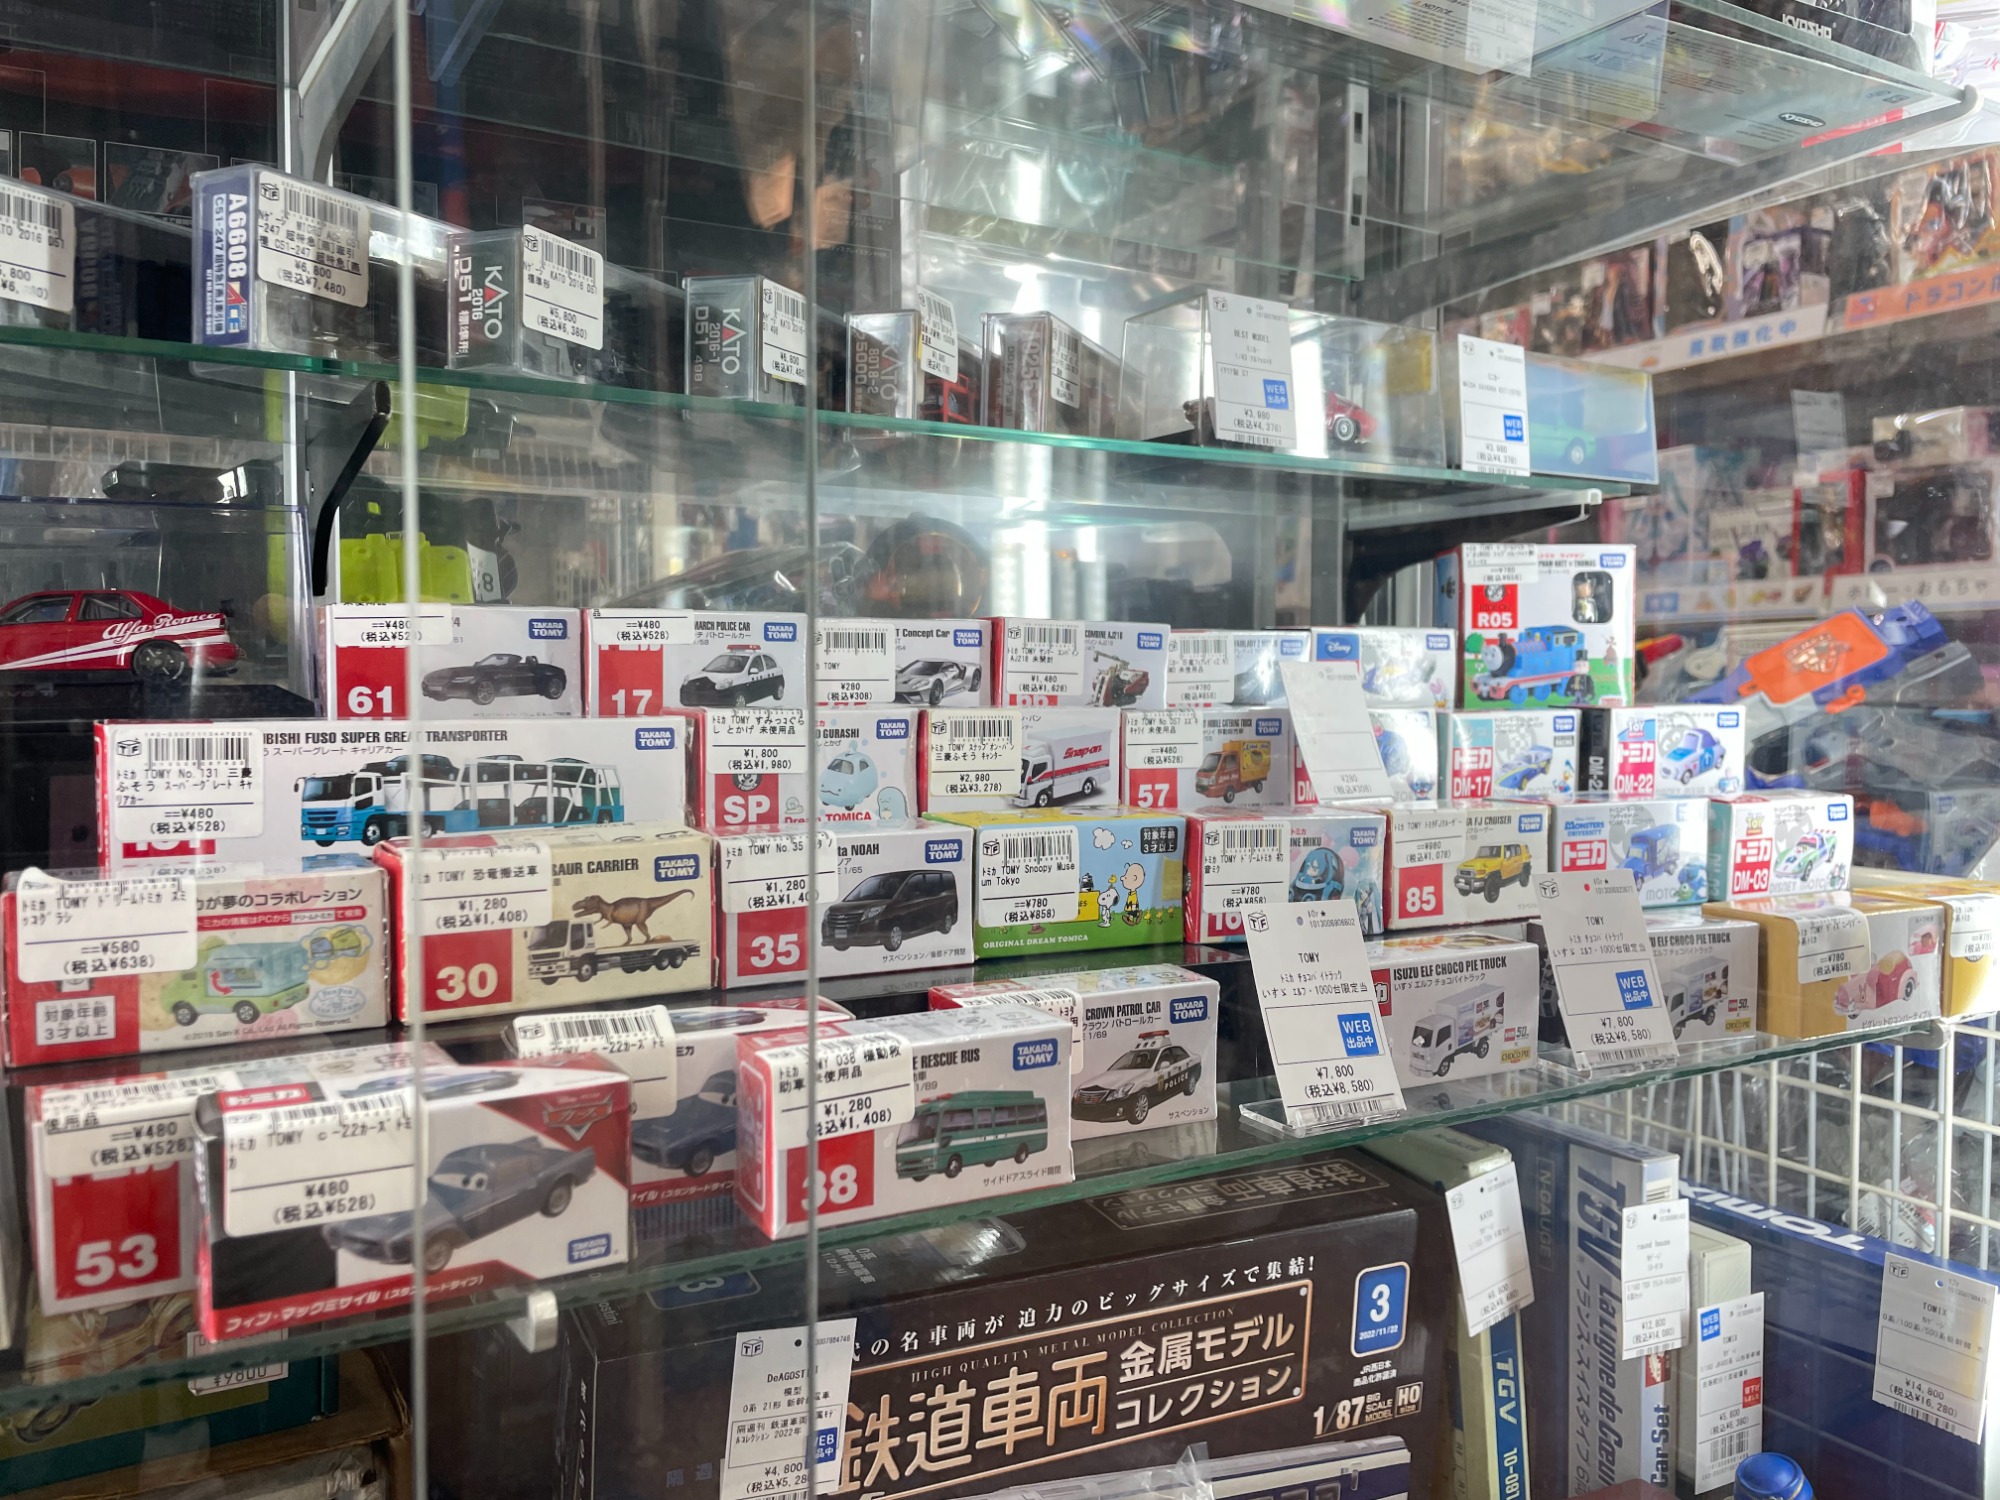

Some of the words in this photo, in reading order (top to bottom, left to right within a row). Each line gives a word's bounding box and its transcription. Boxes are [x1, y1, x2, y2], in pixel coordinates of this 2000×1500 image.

[1782, 13, 1833, 41] KYOSHO
[228, 193, 248, 279] A6608
[458, 255, 472, 303] D51
[471, 287, 484, 321] 2016
[484, 265, 509, 340] KATO
[549, 306, 578, 325] ¥5,800
[536, 314, 588, 340] (税込¥6,380)
[694, 305, 710, 346] D51
[708, 322, 721, 363] 2016-1
[721, 308, 748, 376] KATO
[1266, 384, 1286, 396] WEB
[102, 620, 153, 645] Alfa
[153, 611, 217, 630] Romeo
[531, 621, 564, 630] TAKARA
[716, 621, 740, 632] POLICE
[740, 621, 751, 632] CAR
[1477, 612, 1513, 628] R05
[531, 629, 564, 638] TOMY
[616, 631, 670, 641] (税込¥528)
[766, 632, 794, 640] TOMY
[902, 628, 936, 640] Concept
[935, 628, 951, 638] Car
[1139, 641, 1161, 649] TOMY
[1325, 641, 1352, 655] Disney
[840, 682, 861, 691] ¥280
[347, 685, 394, 715] 61
[611, 688, 653, 716] 17
[827, 691, 873, 701] (税込¥308)
[731, 716, 750, 724] TOMY
[879, 721, 906, 730] TAKARA
[305, 731, 337, 744] FUSO
[340, 731, 381, 744] SUPER
[425, 729, 508, 743] TRANSPORTER
[638, 730, 672, 739] TAKARA
[726, 725, 754, 735] とかげ
[759, 725, 796, 735] 未使用品
[822, 727, 860, 739] GURASHI
[879, 729, 906, 737] TOMY
[638, 738, 672, 748] TOMY
[743, 749, 779, 758] ¥1,800
[1062, 744, 1104, 760] Snap-on
[1453, 749, 1492, 771] トミカ
[1618, 741, 1655, 763] トミカ
[727, 759, 792, 770] (税込¥1,980)
[1143, 756, 1184, 765] (税込¥528)
[144, 768, 171, 779] TOMY
[959, 773, 990, 783] ¥2,980
[116, 781, 156, 792] ふそう
[944, 782, 1003, 793] (税込¥3,278)
[1453, 776, 1491, 798] DM-17
[1614, 773, 1654, 794] DM-22
[1137, 783, 1170, 809] 57
[723, 794, 771, 825] SP
[824, 810, 872, 822] TOMICA
[149, 819, 226, 835] (税込¥528)
[1483, 814, 1512, 826] CRUISER
[1564, 819, 1605, 831] MONSTERS
[928, 842, 960, 852] TAKARA
[1303, 836, 1322, 847] MIKU
[1352, 836, 1377, 845] TOMY
[850, 843, 880, 857] NOAH
[928, 850, 960, 860] TOMY
[1563, 841, 1606, 867] トミカ
[1735, 838, 1772, 864] トミカ
[586, 857, 640, 875] CARRIER
[657, 857, 697, 869] TAKARA
[1001, 864, 1020, 876] TOMY
[1024, 863, 1053, 875] Snoopy
[657, 867, 697, 880] TOMY
[997, 876, 1020, 886] Tokyo
[1733, 868, 1769, 891] DM-03
[765, 879, 807, 894] ¥1,280
[458, 897, 508, 912] ¥1,280
[1405, 885, 1436, 913] 85
[435, 911, 529, 930] (税込¥1,408)
[1004, 909, 1056, 924] (税込¥858)
[982, 938, 1025, 949] ORIGINAL
[1026, 936, 1056, 947] DREAM
[1057, 934, 1089, 944] TOMICA
[1669, 934, 1695, 947] CHOCO
[1706, 932, 1731, 944] TRUCK
[749, 932, 800, 968] 35
[1297, 951, 1320, 964] TOMY
[63, 955, 155, 974] (税込¥638)
[1393, 967, 1420, 981] ISUZU
[1420, 965, 1434, 978] ELF
[1435, 962, 1465, 976] CHOCO
[1465, 959, 1479, 973] PIE
[1479, 955, 1508, 971] TRUCK
[435, 962, 499, 1003] 30
[1619, 975, 1646, 990] WEB
[1173, 999, 1205, 1010] TAKARA
[1624, 990, 1649, 1003] 出品中
[1085, 1005, 1116, 1022] CROWN
[1116, 1002, 1145, 1018] PATROL
[1145, 1000, 1162, 1014] CAR
[1173, 1008, 1206, 1021] TOMY
[1341, 1019, 1372, 1034] WEB
[1600, 1016, 1634, 1028] ¥7,800
[44, 1025, 108, 1041] 3才以上
[1590, 1029, 1652, 1045] (税込¥8,580)
[1017, 1042, 1054, 1056] TAKARA
[1346, 1035, 1374, 1049] 出品中
[920, 1051, 958, 1070] RESCUE
[960, 1048, 981, 1064] BUS
[1017, 1052, 1055, 1068] TOMY
[1316, 1064, 1355, 1079] ¥7,800
[1164, 1072, 1190, 1090] POLICE
[1304, 1078, 1375, 1099] (税込¥8,580)
[824, 1096, 873, 1117] ¥1,280
[266, 1131, 304, 1149] TOMY
[305, 1179, 349, 1197] ¥480
[801, 1163, 858, 1210] 38
[273, 1194, 376, 1225] (税込¥528)
[1576, 1165, 1629, 1281] TGV
[572, 1238, 608, 1252] TAKARA
[572, 1246, 609, 1260] TOMY
[74, 1233, 158, 1287] 53
[1369, 1283, 1391, 1323] 3
[1922, 1301, 1948, 1317] TOMIX
[225, 1289, 382, 1334] フィン・マックミサイル
[1701, 1312, 1719, 1326] WEB
[1358, 1324, 1400, 1341] 2022/11/22
[911, 1368, 953, 1384] HIGH
[958, 1348, 1032, 1373] QUALITY
[1038, 1335, 1090, 1358] METAL
[1096, 1324, 1146, 1345] MODEL
[1150, 1307, 1236, 1333] COLLECTION
[1118, 1311, 1297, 1384] 金属モデル
[1359, 1359, 1393, 1375] JR西日本
[1397, 1384, 1421, 1407] HO
[1494, 1356, 1518, 1426] TGV
[1904, 1377, 1946, 1401] ¥14,800
[1115, 1364, 1293, 1431] コレクション
[1365, 1392, 1381, 1404] BIG
[1889, 1383, 1959, 1419] (税込¥16,280)
[1365, 1399, 1394, 1413] SCALE
[1312, 1395, 1366, 1437] 1/87
[1364, 1408, 1394, 1423] MODEL
[1649, 1403, 1671, 1446] Set
[764, 1462, 803, 1477] ¥4,800
[1649, 1447, 1671, 1488] Car
